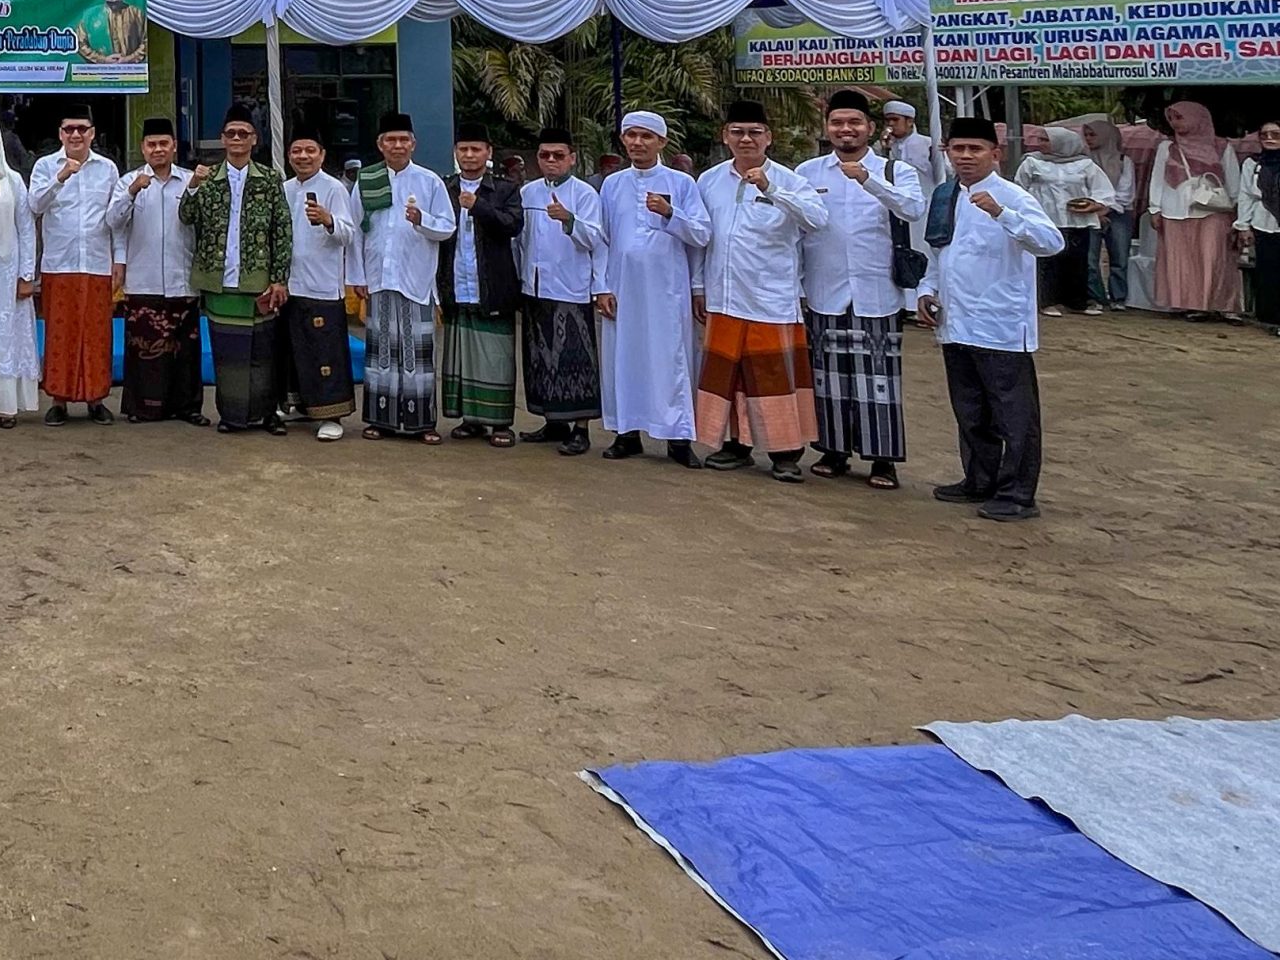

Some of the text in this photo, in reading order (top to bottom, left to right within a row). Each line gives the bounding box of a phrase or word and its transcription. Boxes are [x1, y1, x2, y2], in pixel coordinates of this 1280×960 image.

[1020, 6, 1121, 24] JABATAN,
[749, 39, 794, 52] KALAU
[799, 39, 828, 51] KAU
[834, 37, 878, 49] TIDAK
[976, 31, 1038, 46] UNTUK
[1044, 28, 1128, 44] URUSAN
[1135, 24, 1220, 41] AGAMA
[763, 52, 884, 66] BERJUANGLAH
[937, 49, 978, 63] DAN
[985, 46, 1038, 63] LAGI,
[1046, 45, 1096, 60] LAGI
[1104, 44, 1155, 60] DAN
[1164, 42, 1230, 61] LAGI,
[737, 69, 765, 83] INFAQ
[774, 68, 824, 82] SODAQOH
[826, 68, 856, 81] BANK
[858, 67, 874, 80] BSI
[887, 67, 900, 80] No
[981, 65, 998, 79] A/n
[999, 66, 1050, 79] Pesantren
[1053, 63, 1148, 79] Mahabbaturrosul
[1151, 63, 1177, 78] SAW
